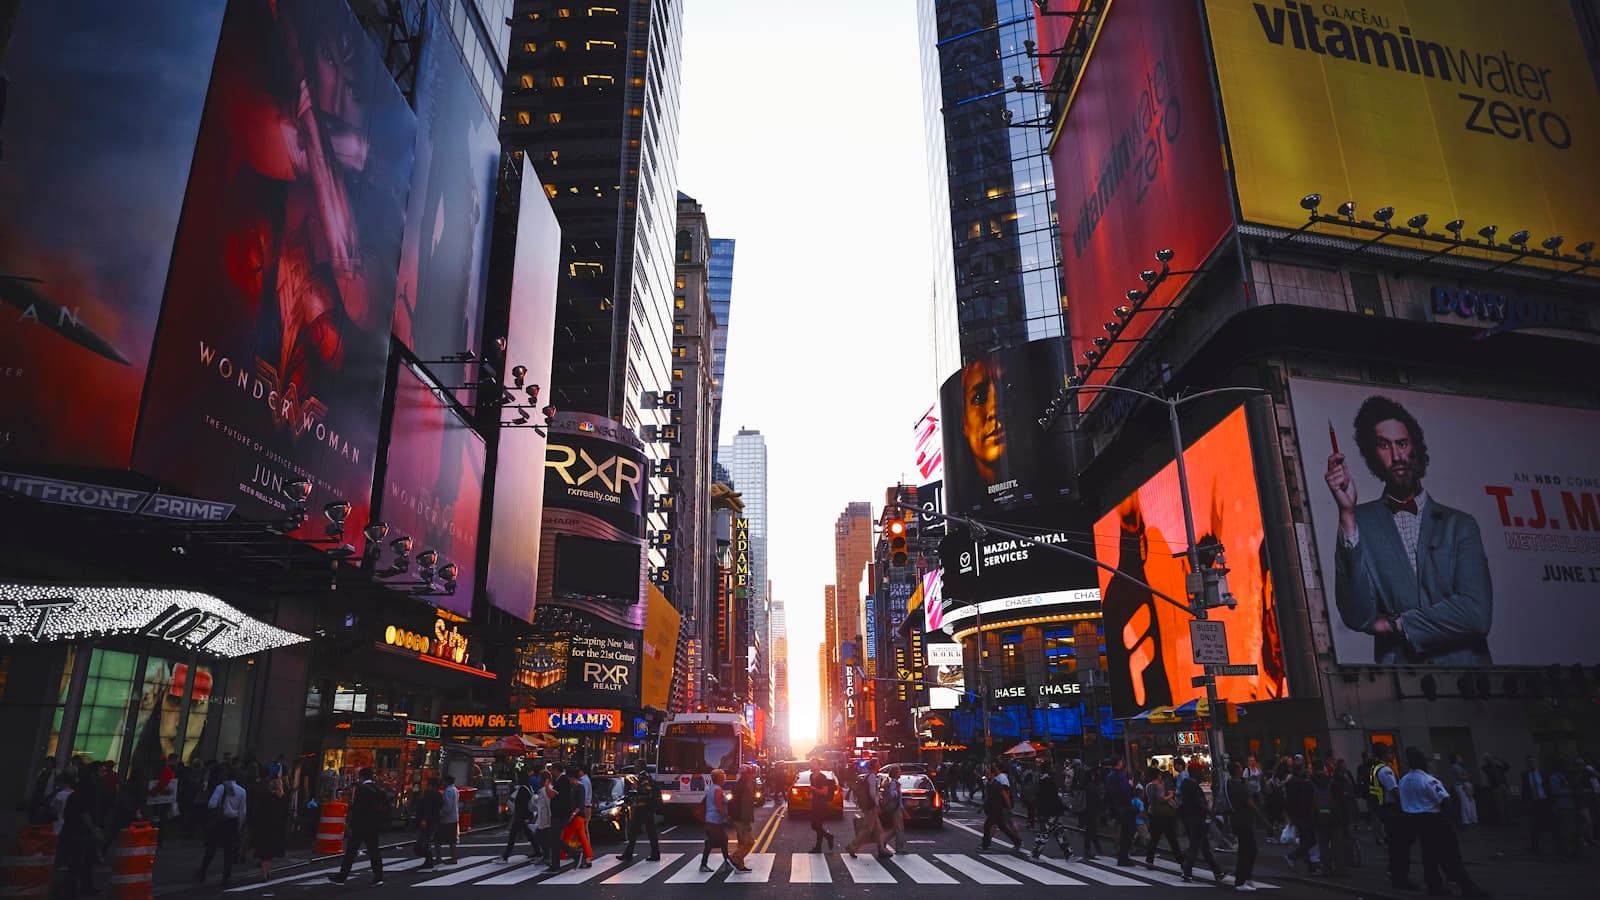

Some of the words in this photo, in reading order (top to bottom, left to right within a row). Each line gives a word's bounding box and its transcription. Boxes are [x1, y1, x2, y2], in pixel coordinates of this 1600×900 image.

[1459, 92, 1572, 149] zero
[1133, 95, 1181, 205] zero
[0, 298, 81, 329] AN
[0, 368, 25, 377] ER
[200, 341, 290, 419] WONDER
[302, 411, 360, 465] WOMAN
[205, 415, 220, 429] THE
[223, 424, 251, 447] FUTURE
[253, 442, 263, 453] OF
[265, 449, 292, 470] JUSTICE
[251, 463, 288, 494] JUN
[544, 443, 642, 502] RXR
[1513, 472, 1529, 482] AN
[1535, 474, 1561, 485] HBO
[391, 481, 438, 527] WONDER
[567, 486, 621, 505] rxrrealty.com
[153, 497, 225, 519] PRIME
[542, 517, 580, 527] SHARP
[735, 516, 748, 587] MADAME
[983, 540, 1017, 556] MAZDA
[983, 549, 1029, 568] SERVICES
[1543, 565, 1585, 582] JUNE
[1005, 597, 1033, 608] CHASE
[1196, 624, 1218, 632] BUSES
[1200, 633, 1217, 641] ONLY
[607, 638, 623, 648] New
[623, 640, 635, 650] York
[912, 630, 922, 668] VICTORY
[572, 647, 585, 657] for
[587, 648, 600, 658] the
[600, 650, 614, 660] 21st
[615, 651, 637, 664] Century
[583, 661, 629, 686] RXR
[593, 682, 622, 693] REALTY
[844, 667, 855, 719] REGAL
[1039, 683, 1081, 696] CHASE
[452, 715, 486, 727] KNOW
[547, 710, 613, 730] CHAMPS
[1178, 732, 1200, 744] SODA
